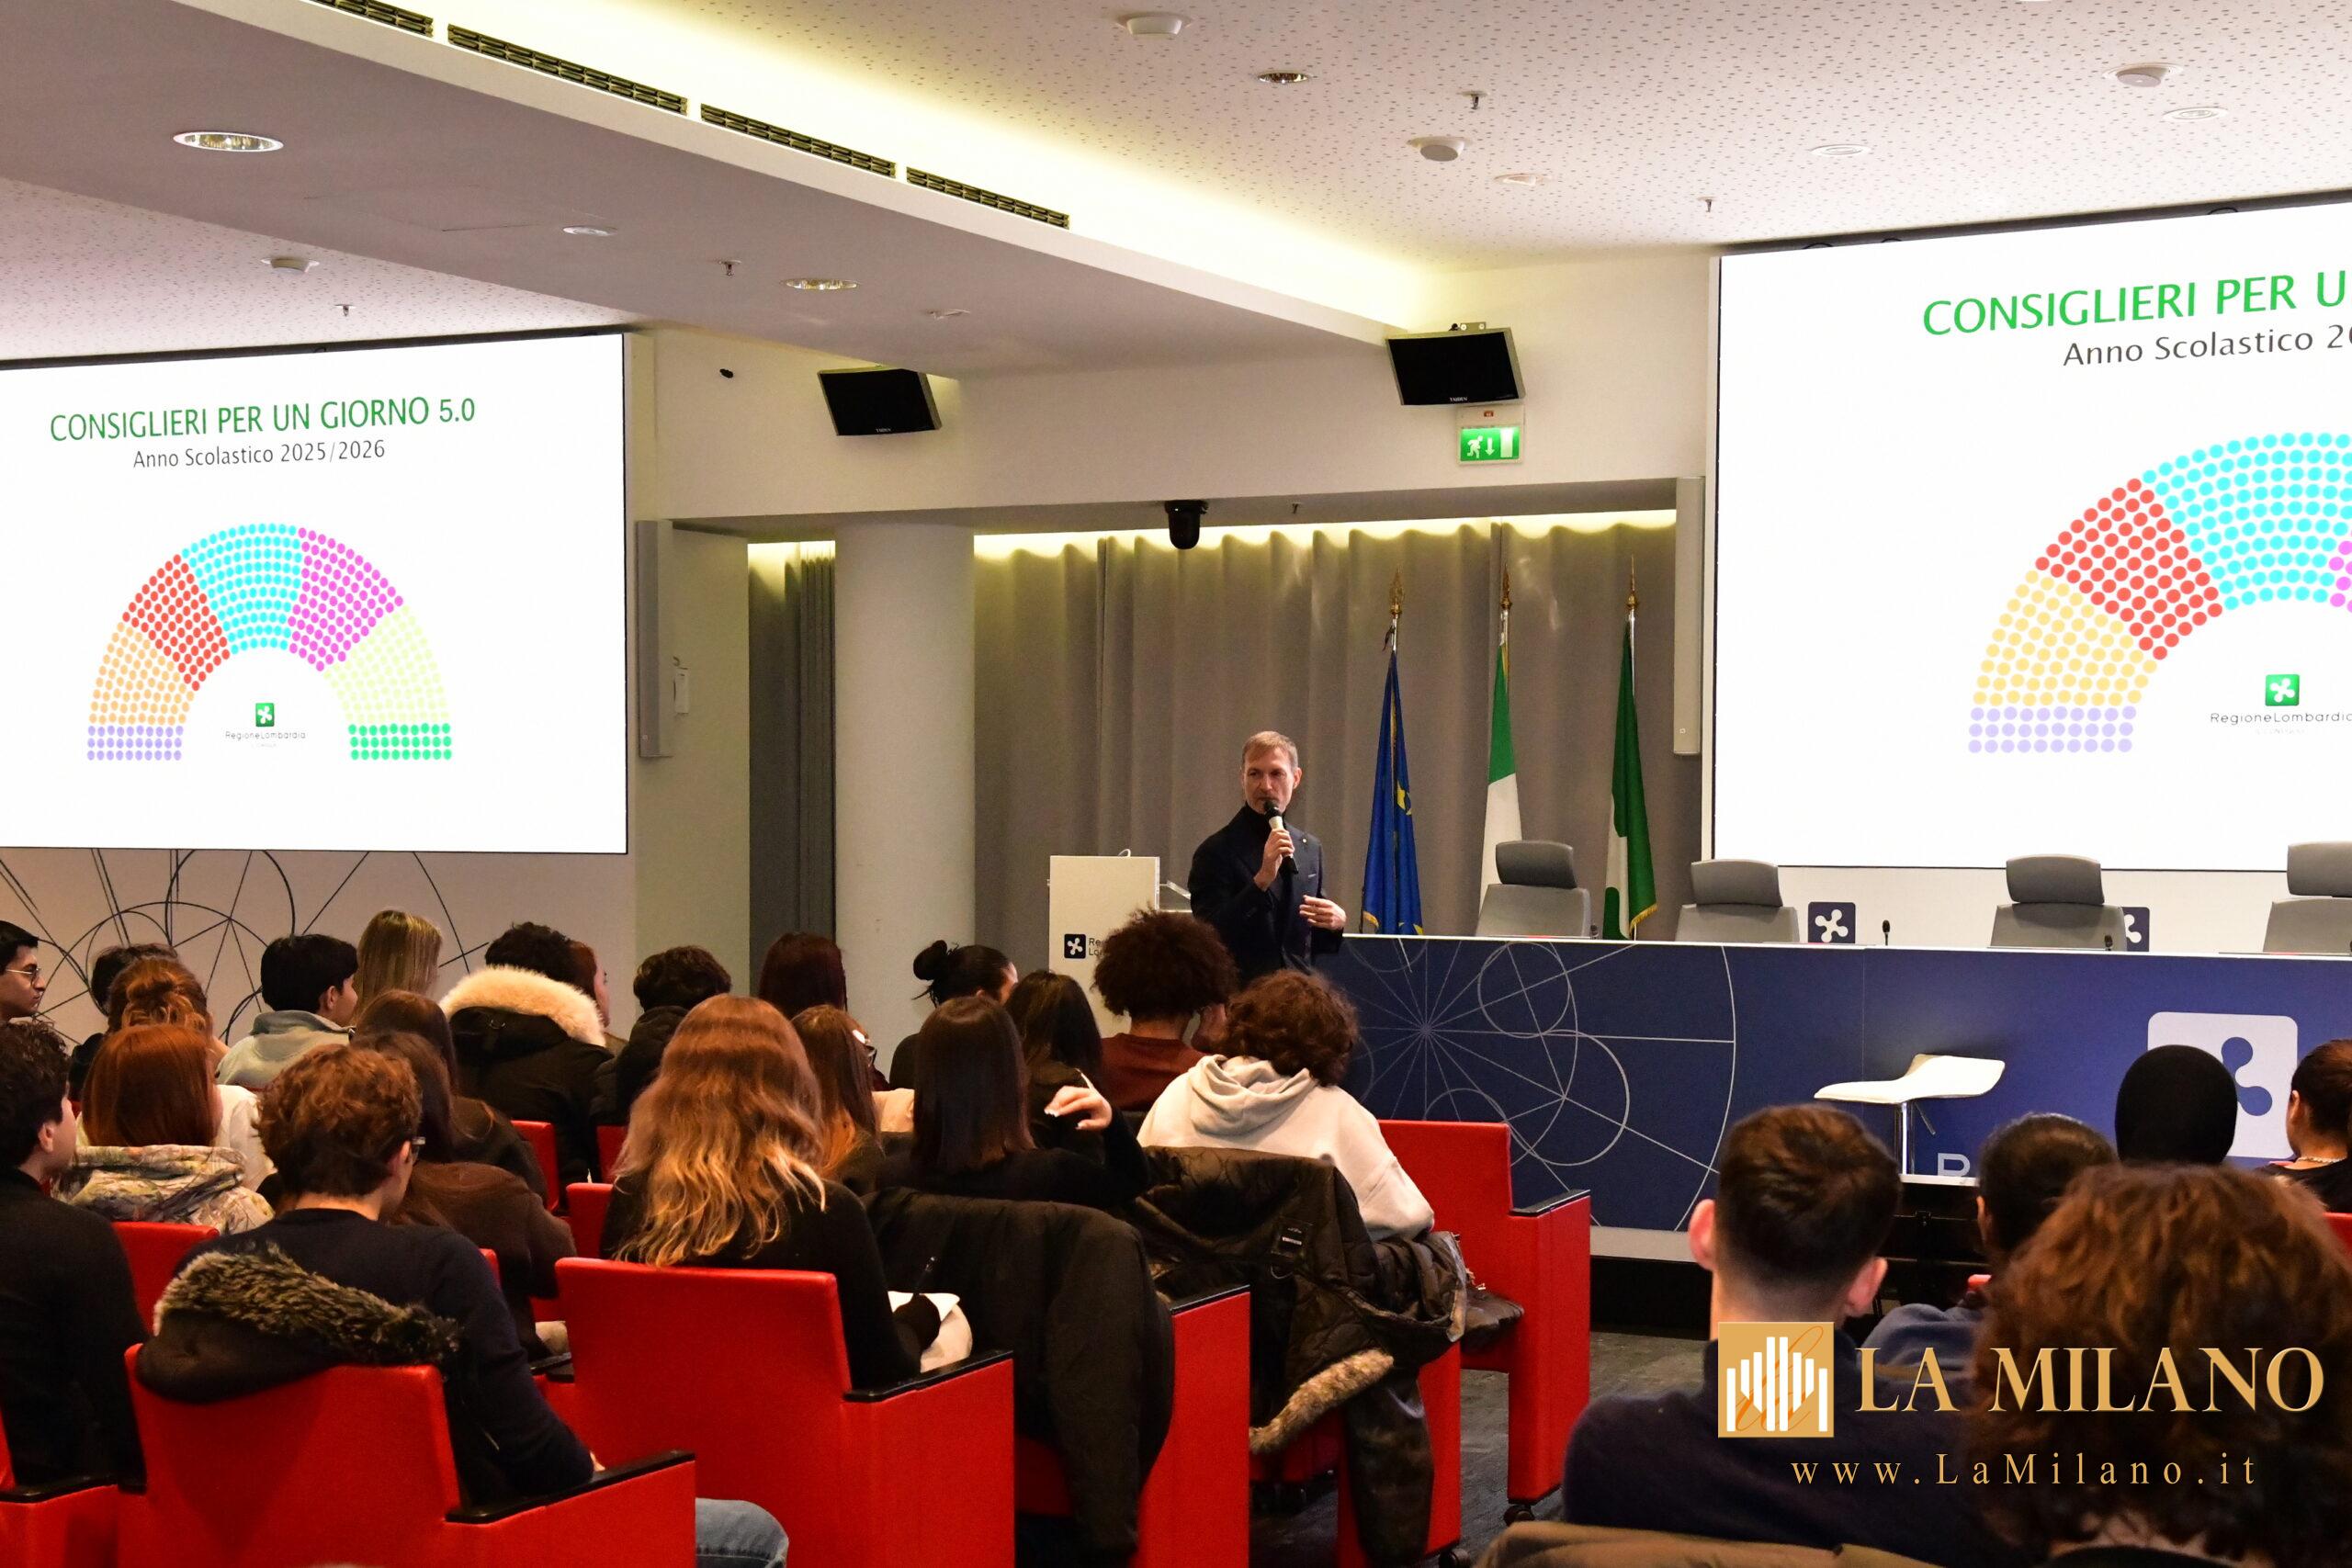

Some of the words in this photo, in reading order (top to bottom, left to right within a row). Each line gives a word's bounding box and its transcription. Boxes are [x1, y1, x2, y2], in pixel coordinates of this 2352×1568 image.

[1922, 282, 2197, 336] CONSIGLIERI
[2216, 275, 2297, 315] PER
[2063, 343, 2143, 367] Anno
[2154, 331, 2313, 361] Scolastico
[2327, 324, 2352, 349] 2
[50, 409, 207, 442] CONSIGLIERI
[218, 405, 264, 434] PER
[273, 403, 310, 431] UN
[320, 397, 430, 430] GIORNO
[439, 397, 475, 423] 5.0
[133, 449, 179, 468] Anno
[185, 446, 274, 467] Scolastico
[280, 440, 385, 463] 2025/2026
